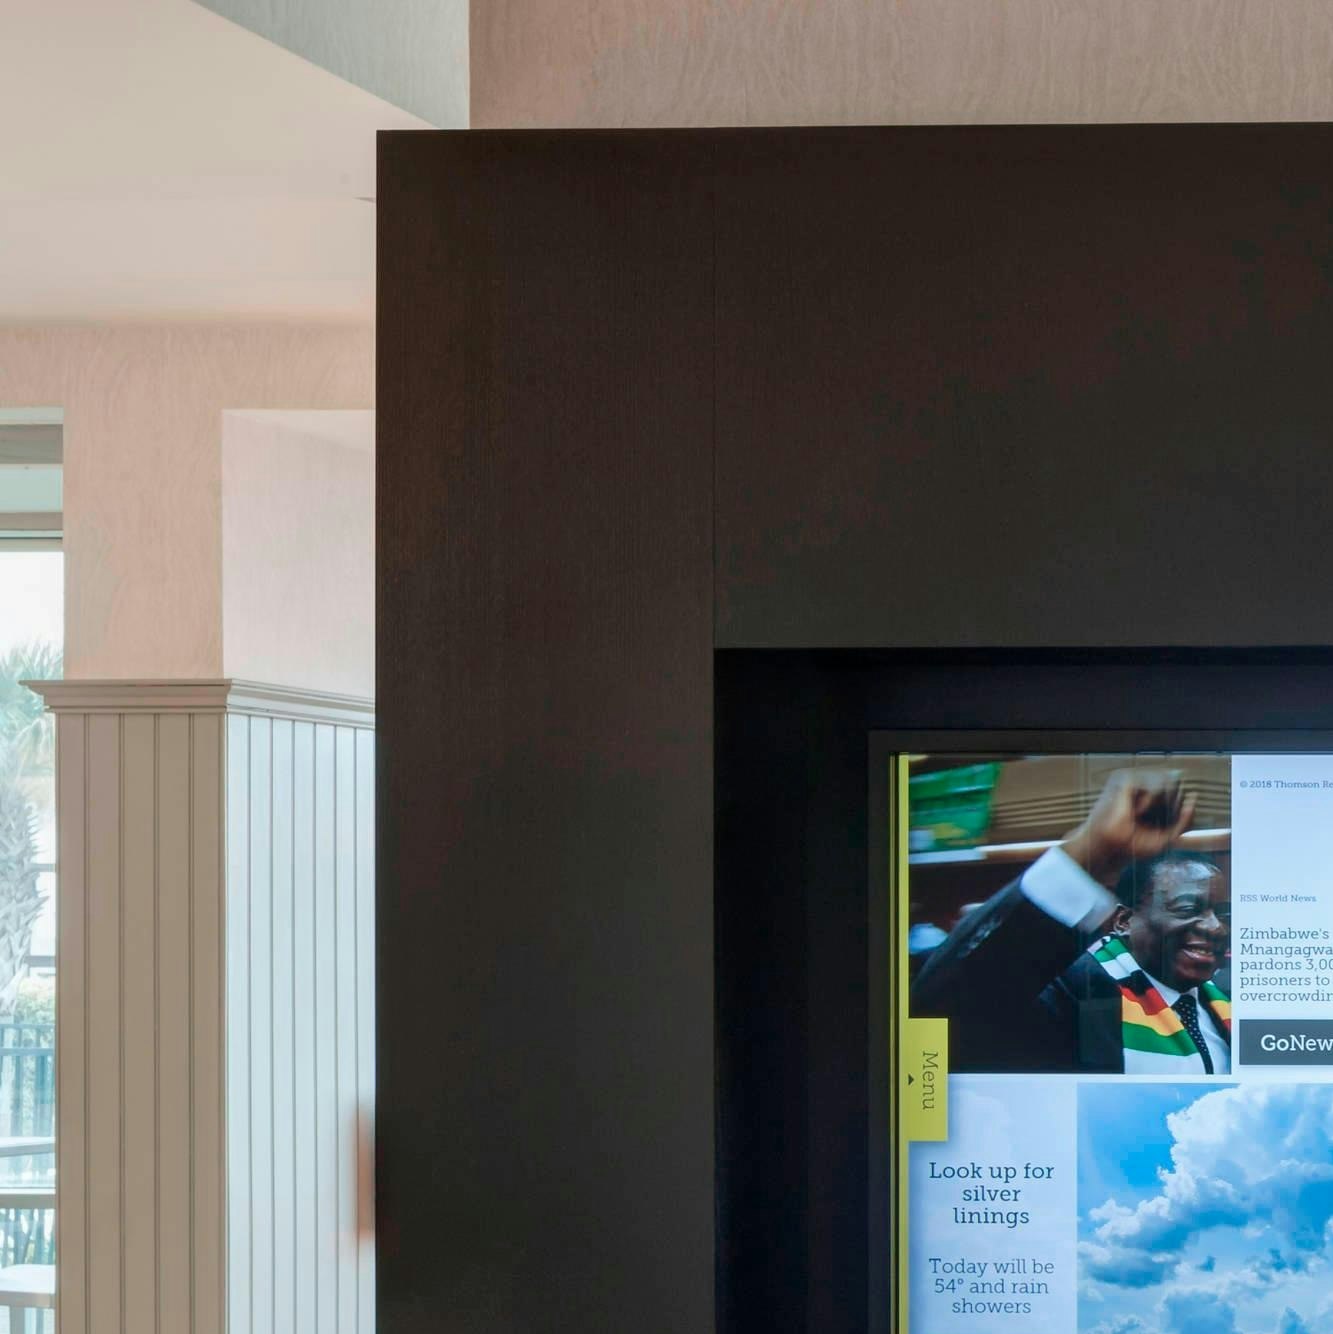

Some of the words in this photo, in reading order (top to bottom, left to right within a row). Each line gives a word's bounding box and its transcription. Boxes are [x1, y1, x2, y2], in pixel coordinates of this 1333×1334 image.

[1250, 780, 1272, 788] 2018
[1274, 780, 1319, 788] Thomson
[1240, 894, 1258, 902] RSS
[1260, 894, 1288, 902] World
[1290, 894, 1316, 902] News
[1240, 928, 1329, 940] Zimbabwe's
[1240, 944, 1333, 958] Mnangagwa
[1240, 958, 1302, 973] pardons
[1240, 974, 1312, 988] prisoners
[1316, 974, 1330, 988] to
[922, 1051, 938, 1110] Menu
[929, 1162, 982, 1179] Look
[989, 1166, 1016, 1183] up
[1024, 1162, 1054, 1179] for
[962, 1185, 1020, 1202] silver
[952, 1208, 1030, 1228] linings
[928, 1258, 988, 1279] Today
[994, 1258, 1026, 1275] will
[1032, 1258, 1056, 1275] be
[934, 1279, 964, 1294] 54°
[969, 1279, 1006, 1294] and
[1009, 1279, 1048, 1294] rain
[952, 1299, 1031, 1314] showers
